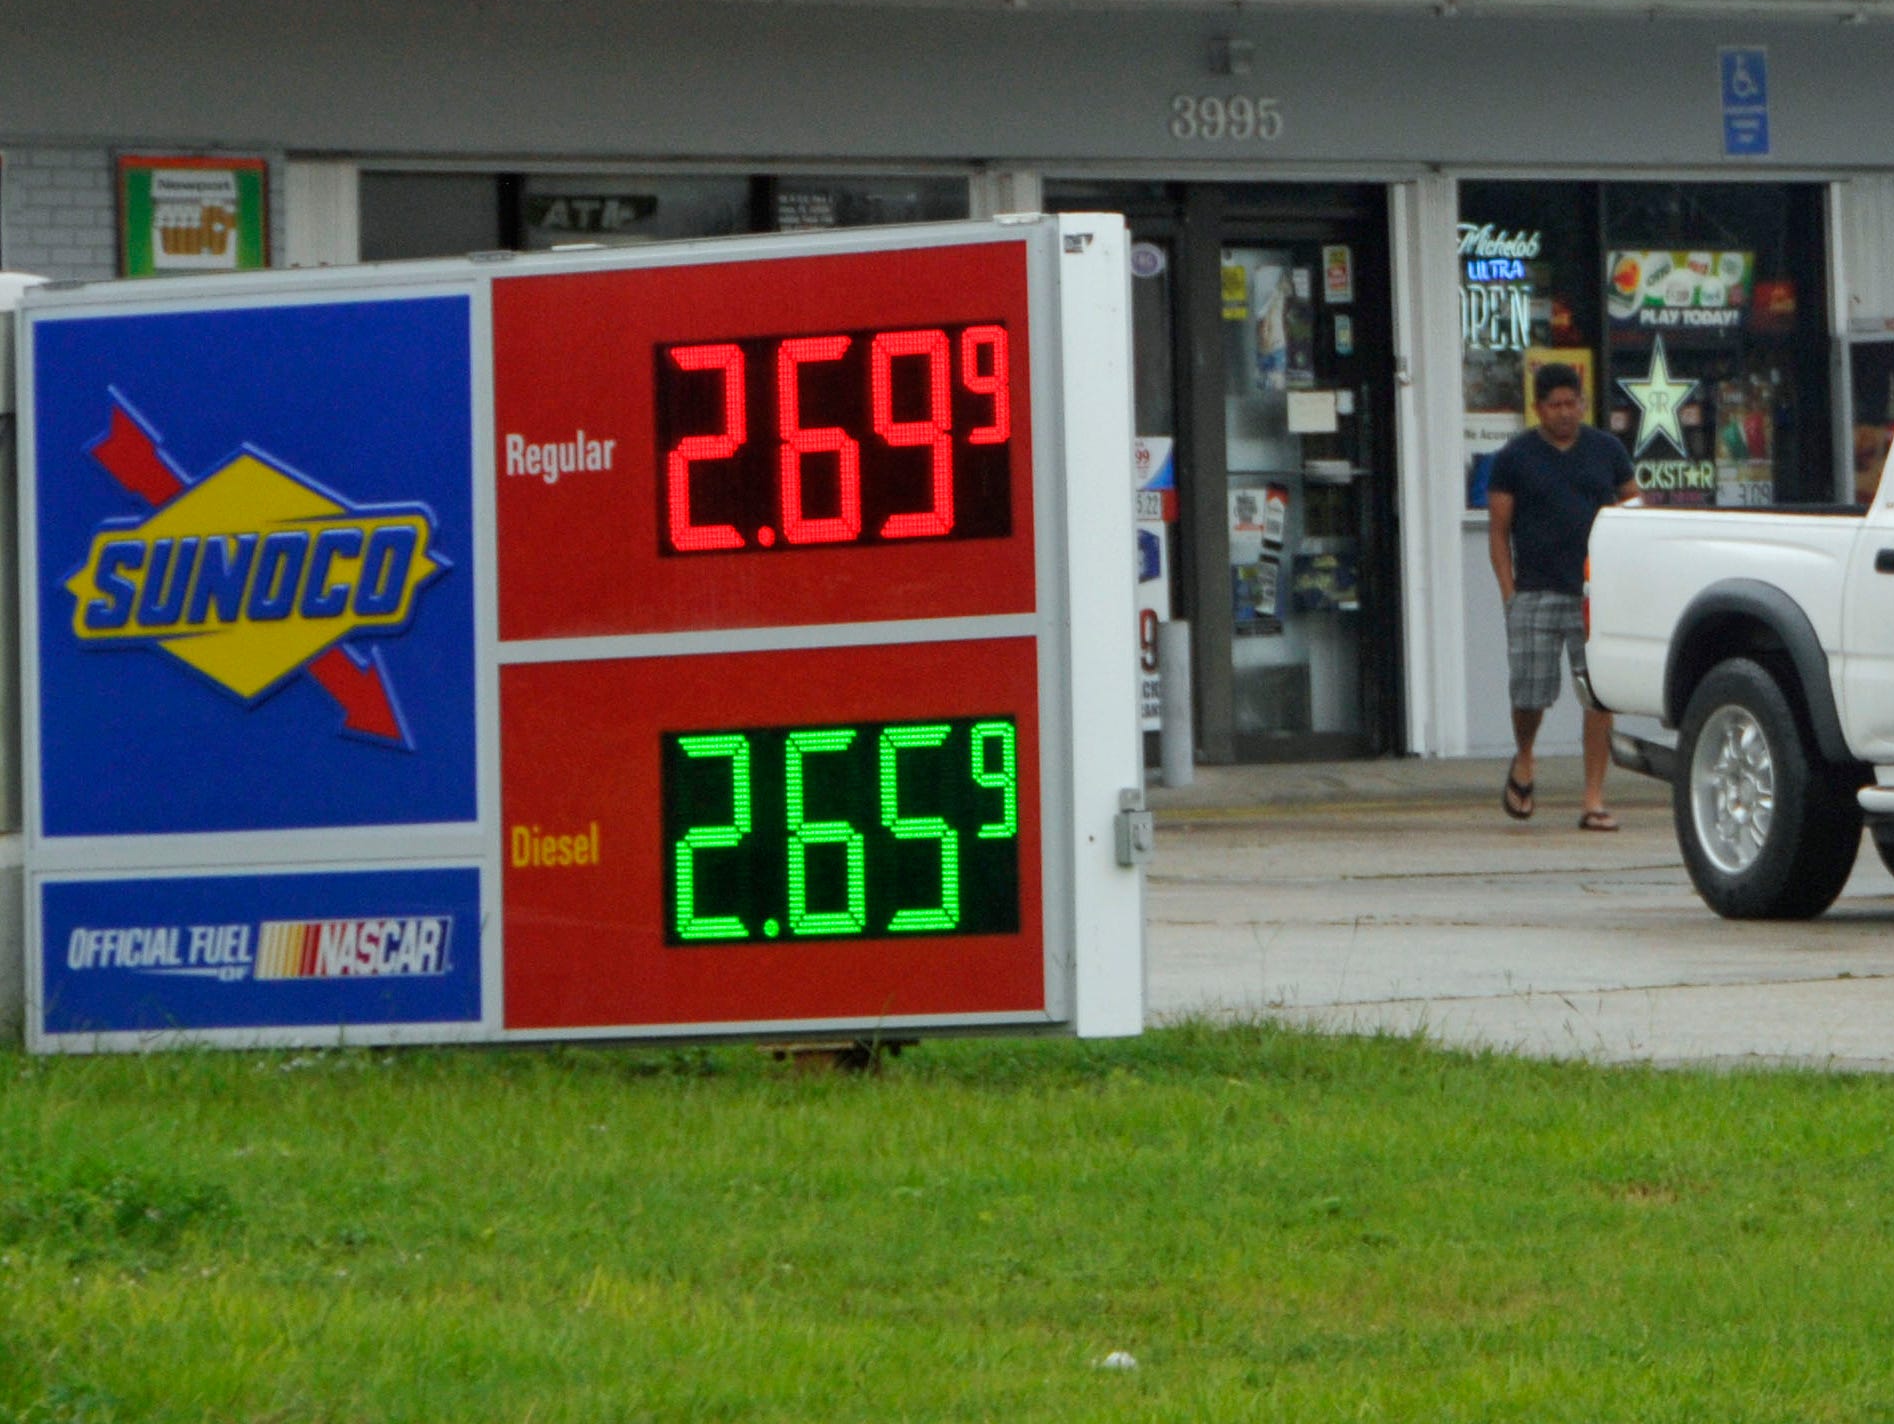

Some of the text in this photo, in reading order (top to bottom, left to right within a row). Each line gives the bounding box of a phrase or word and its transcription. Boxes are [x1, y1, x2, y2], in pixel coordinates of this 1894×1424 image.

[1170, 94, 1284, 142] 3995
[1467, 258, 1526, 281] ULTRA
[1640, 309, 1681, 325] PLAY
[506, 429, 617, 484] Regular
[83, 526, 418, 630] SUNOCO
[511, 822, 600, 869] Diesel
[66, 919, 445, 975] OFFICIAL FUEL NASCAR
